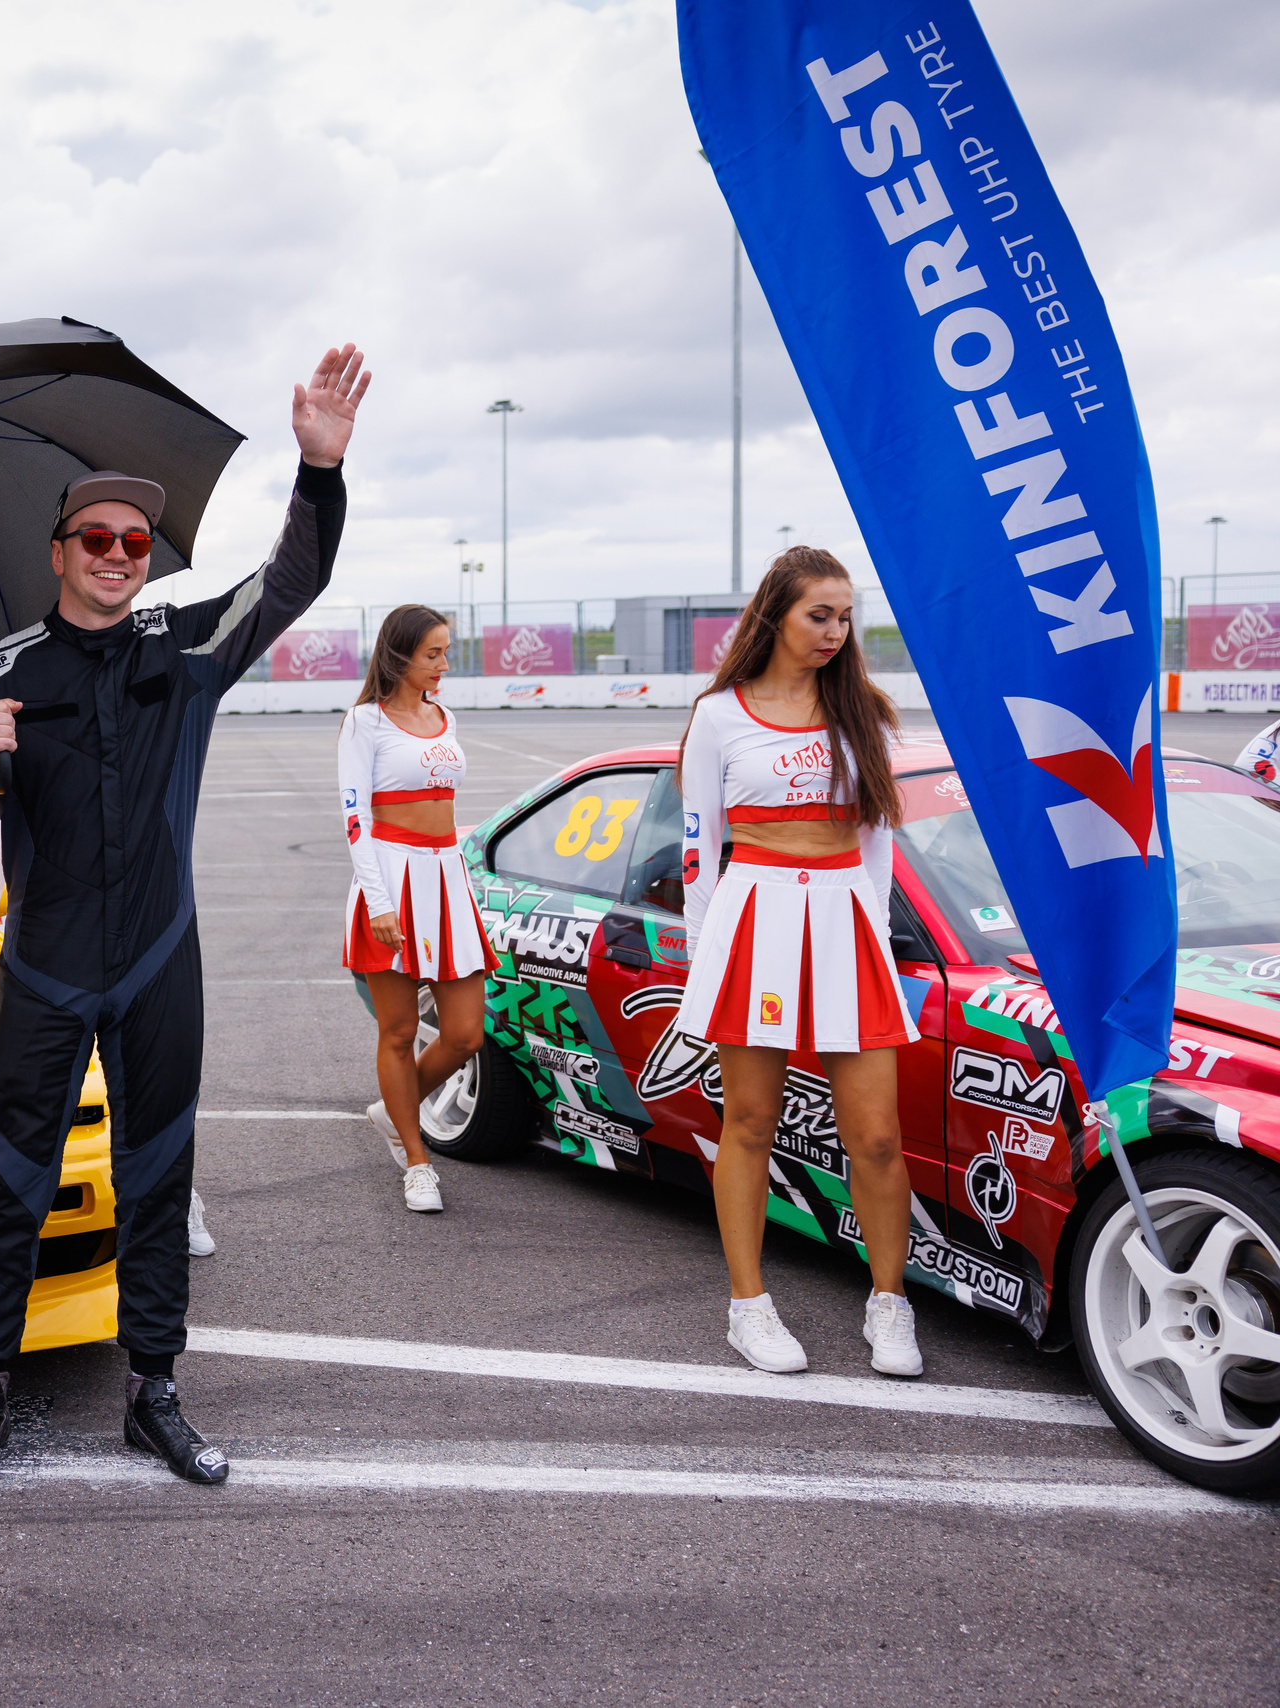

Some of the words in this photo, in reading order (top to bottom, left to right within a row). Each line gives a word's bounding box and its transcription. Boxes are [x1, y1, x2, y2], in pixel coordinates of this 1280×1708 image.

[905, 21, 974, 130] TYRE
[960, 136, 1018, 222] UHP
[1000, 235, 1070, 332] BEST
[805, 50, 1134, 654] KINFOREST
[1051, 339, 1104, 424] THE
[1205, 684, 1267, 701] ИЗВЕСТИЯ
[426, 778, 454, 787] ДРАЙВ
[786, 790, 833, 801] ДРАЙВ
[555, 796, 639, 861] 83
[657, 935, 686, 951] SINT
[519, 962, 563, 980] AUTOMOTIVE
[563, 971, 588, 984] APPAR
[531, 1044, 566, 1063] КУЛЬТУРА
[539, 1057, 566, 1074] ЗАНОСА
[955, 1052, 1060, 1108] PM
[968, 1090, 1053, 1118] POPOVMOTORSPORT
[603, 1135, 637, 1150] CUSTOM
[1030, 1134, 1052, 1145] PESEGOV
[1030, 1141, 1049, 1152] RACING
[775, 1132, 832, 1168] tailing
[1029, 1149, 1046, 1158] PARTS
